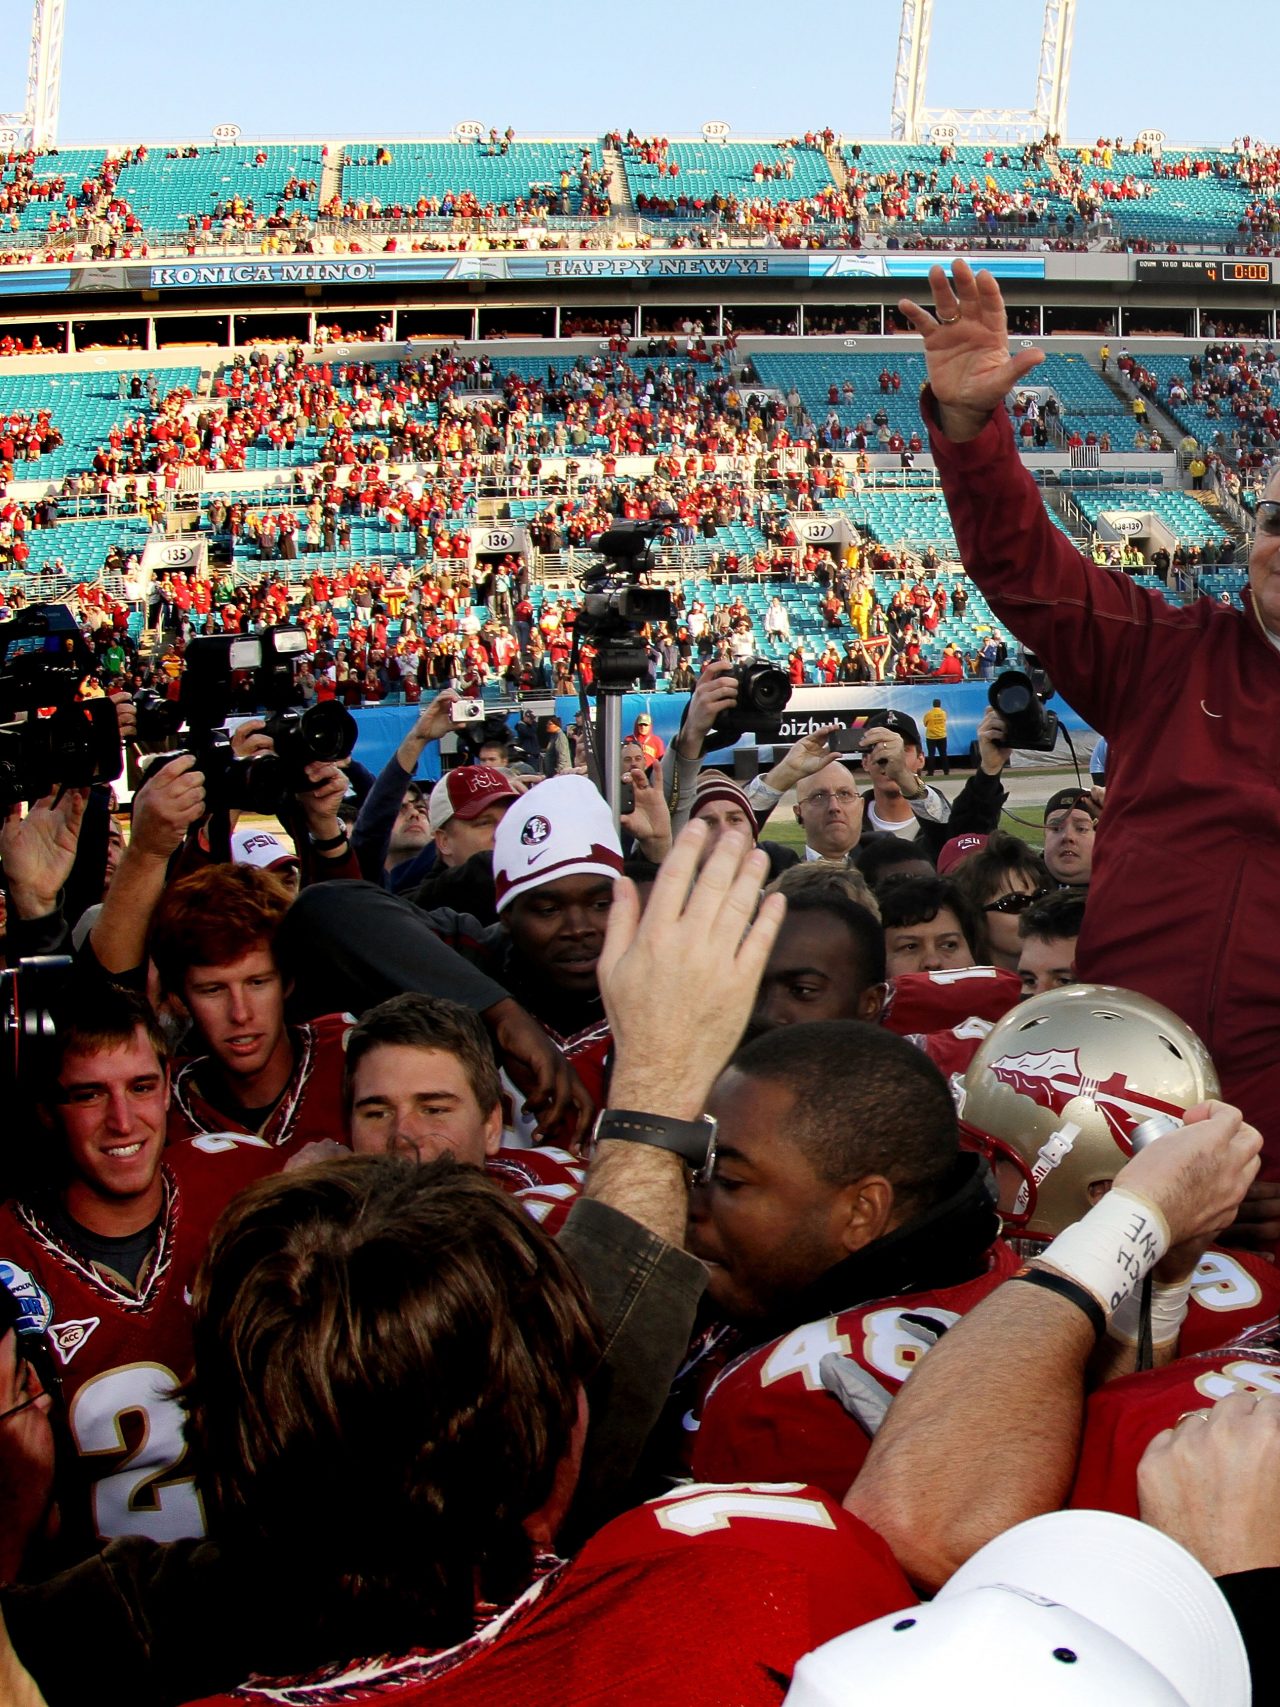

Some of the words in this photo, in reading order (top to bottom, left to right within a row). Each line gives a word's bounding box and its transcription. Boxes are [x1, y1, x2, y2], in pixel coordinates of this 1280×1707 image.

[217, 127, 237, 137] 435
[460, 125, 480, 135] 436
[706, 125, 724, 134] 437
[935, 128, 954, 137] 438
[1141, 132, 1162, 141] 440
[546, 259, 652, 276] HAPPY
[660, 259, 732, 274] NEW
[1234, 264, 1268, 280] 0:00
[153, 266, 274, 286] KONICA
[1207, 270, 1216, 281] 4
[808, 525, 827, 537] 137
[488, 534, 508, 547] 136
[167, 548, 187, 561] 135
[466, 766, 503, 793] FSU
[242, 834, 279, 855] FSU
[957, 836, 981, 848] FSU
[1017, 1165, 1050, 1208] Ridell
[63, 1332, 80, 1344] ACC
[69, 1361, 208, 1543] 2
